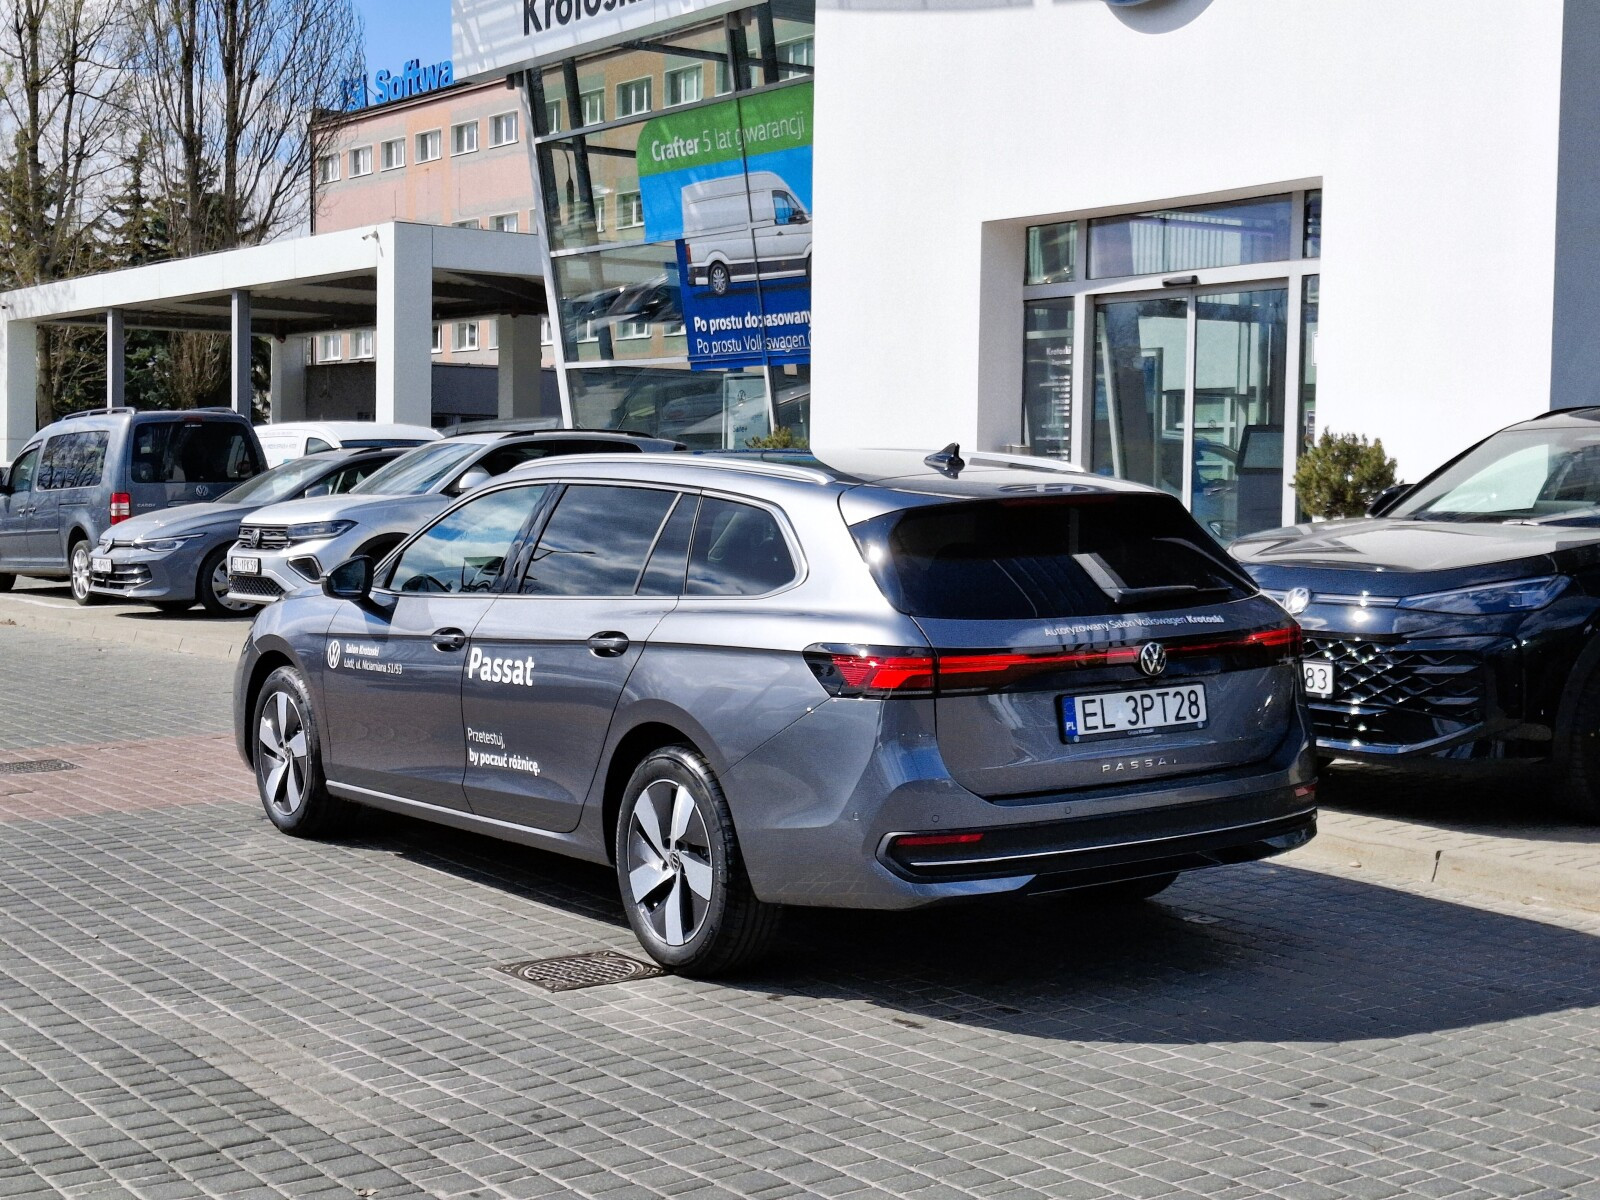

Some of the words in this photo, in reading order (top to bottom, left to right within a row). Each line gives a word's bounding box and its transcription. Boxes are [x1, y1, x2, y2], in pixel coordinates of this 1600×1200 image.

[651, 136, 700, 162] Crafter
[702, 130, 712, 152] 5
[715, 128, 732, 150] lat
[735, 111, 805, 151] gwarancji
[693, 316, 707, 332] Po
[709, 315, 743, 335] prostu
[696, 338, 709, 354] Po
[712, 338, 742, 357] prostu
[1044, 622, 1110, 637] Autoryzowany
[1109, 619, 1135, 629] Salon
[1134, 617, 1187, 627] Volkswagen
[468, 647, 535, 687] Passat
[1081, 698, 1116, 731] EL
[1125, 690, 1201, 726] 3PT28
[1066, 721, 1077, 731] PL
[467, 727, 506, 749] Przetestuj,
[468, 747, 479, 766] by
[480, 753, 508, 768] poczuć
[508, 754, 541, 776] różnicę.
